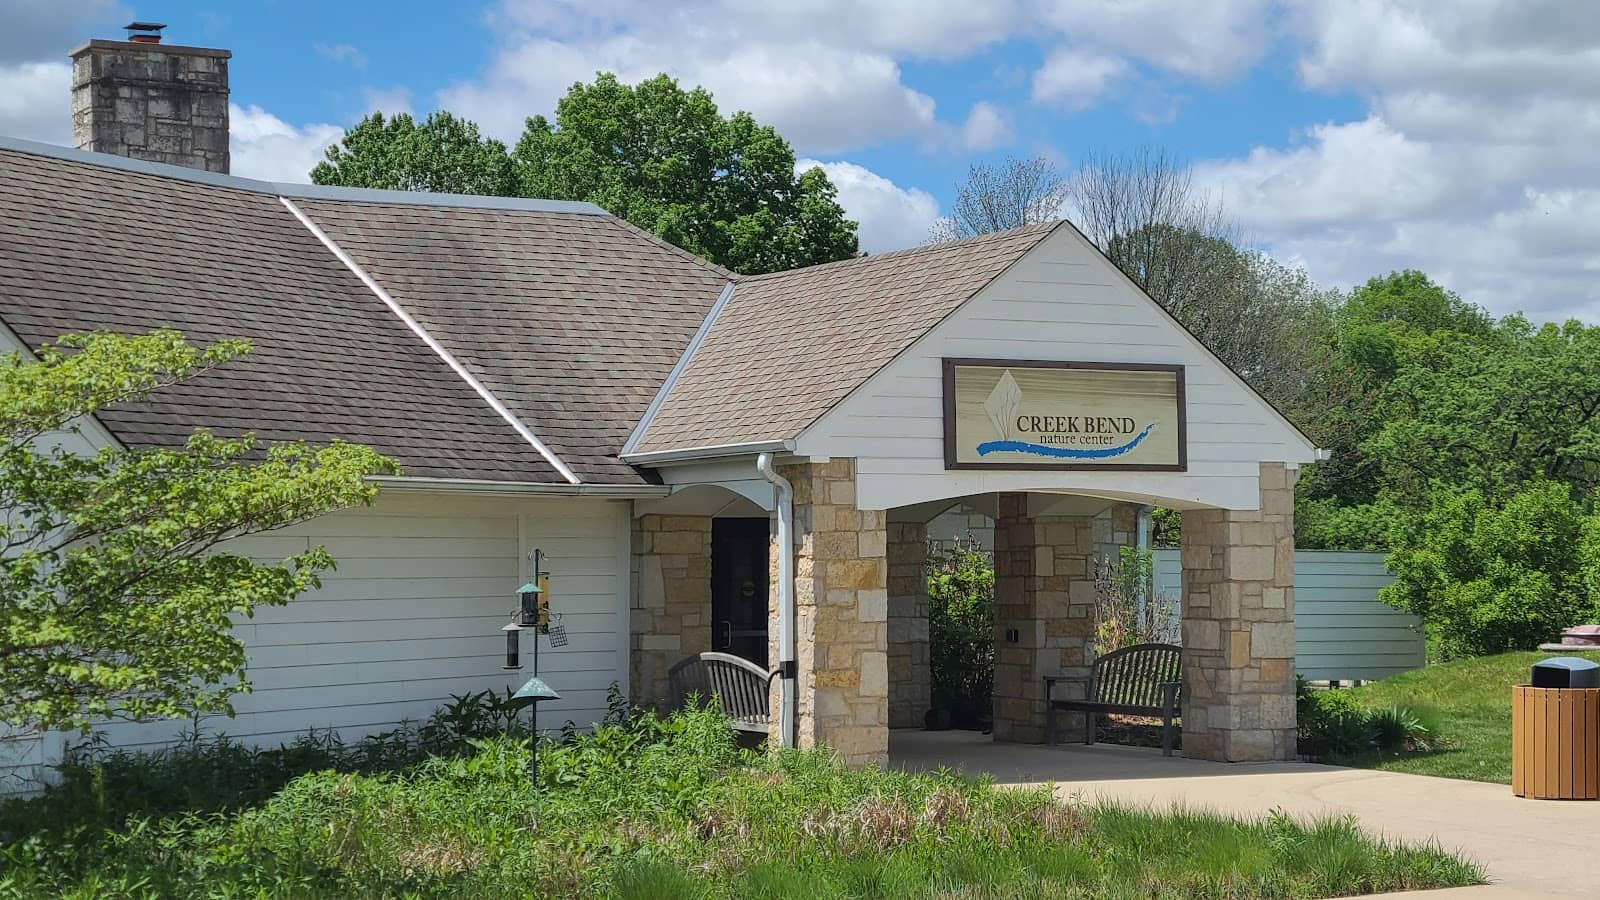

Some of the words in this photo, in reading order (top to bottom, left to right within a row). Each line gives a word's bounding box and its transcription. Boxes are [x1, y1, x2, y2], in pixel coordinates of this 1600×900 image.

[1017, 415, 1079, 433] CREEK
[1085, 416, 1136, 434] BEND
[1040, 433, 1077, 445] nature
[1079, 434, 1115, 445] center
